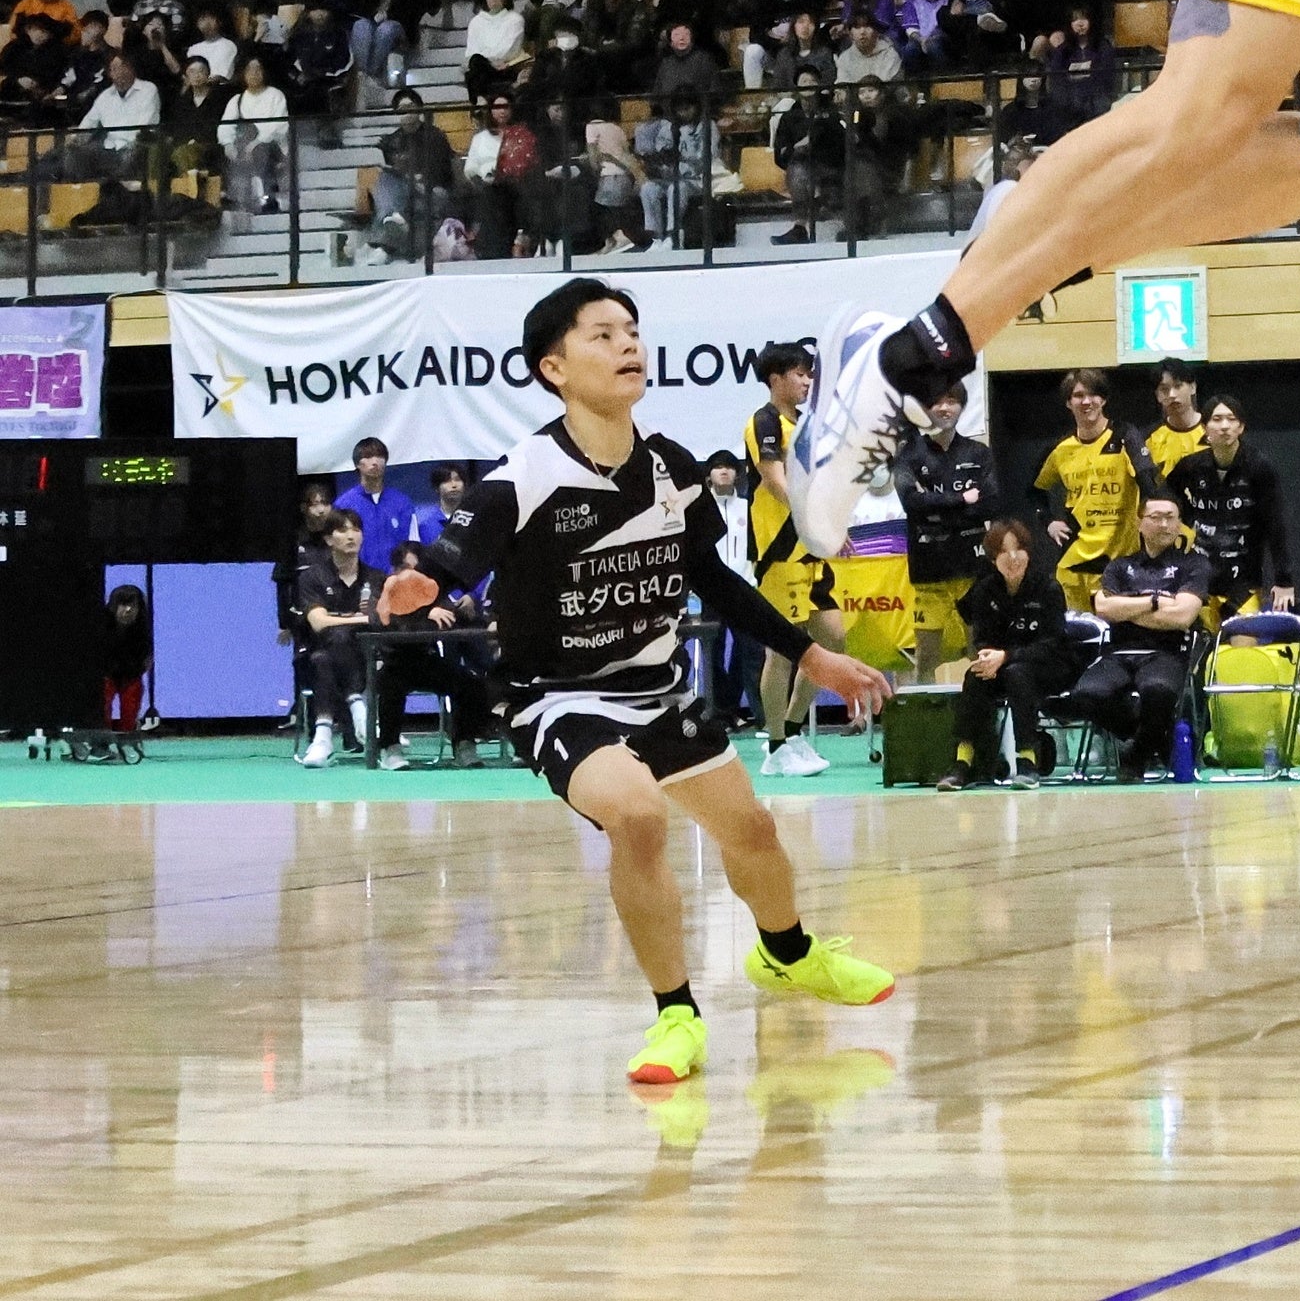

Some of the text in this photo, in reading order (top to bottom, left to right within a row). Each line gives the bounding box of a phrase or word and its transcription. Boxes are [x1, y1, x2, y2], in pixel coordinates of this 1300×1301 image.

[265, 345, 536, 405] HOKKAIDO
[555, 503, 591, 521] TOHO
[555, 514, 599, 533] RESORT
[646, 543, 680, 566] GEAD
[790, 605, 798, 618] 2
[843, 595, 905, 612] IKASA
[561, 627, 625, 649] DONGURI
[553, 737, 569, 761] 1
